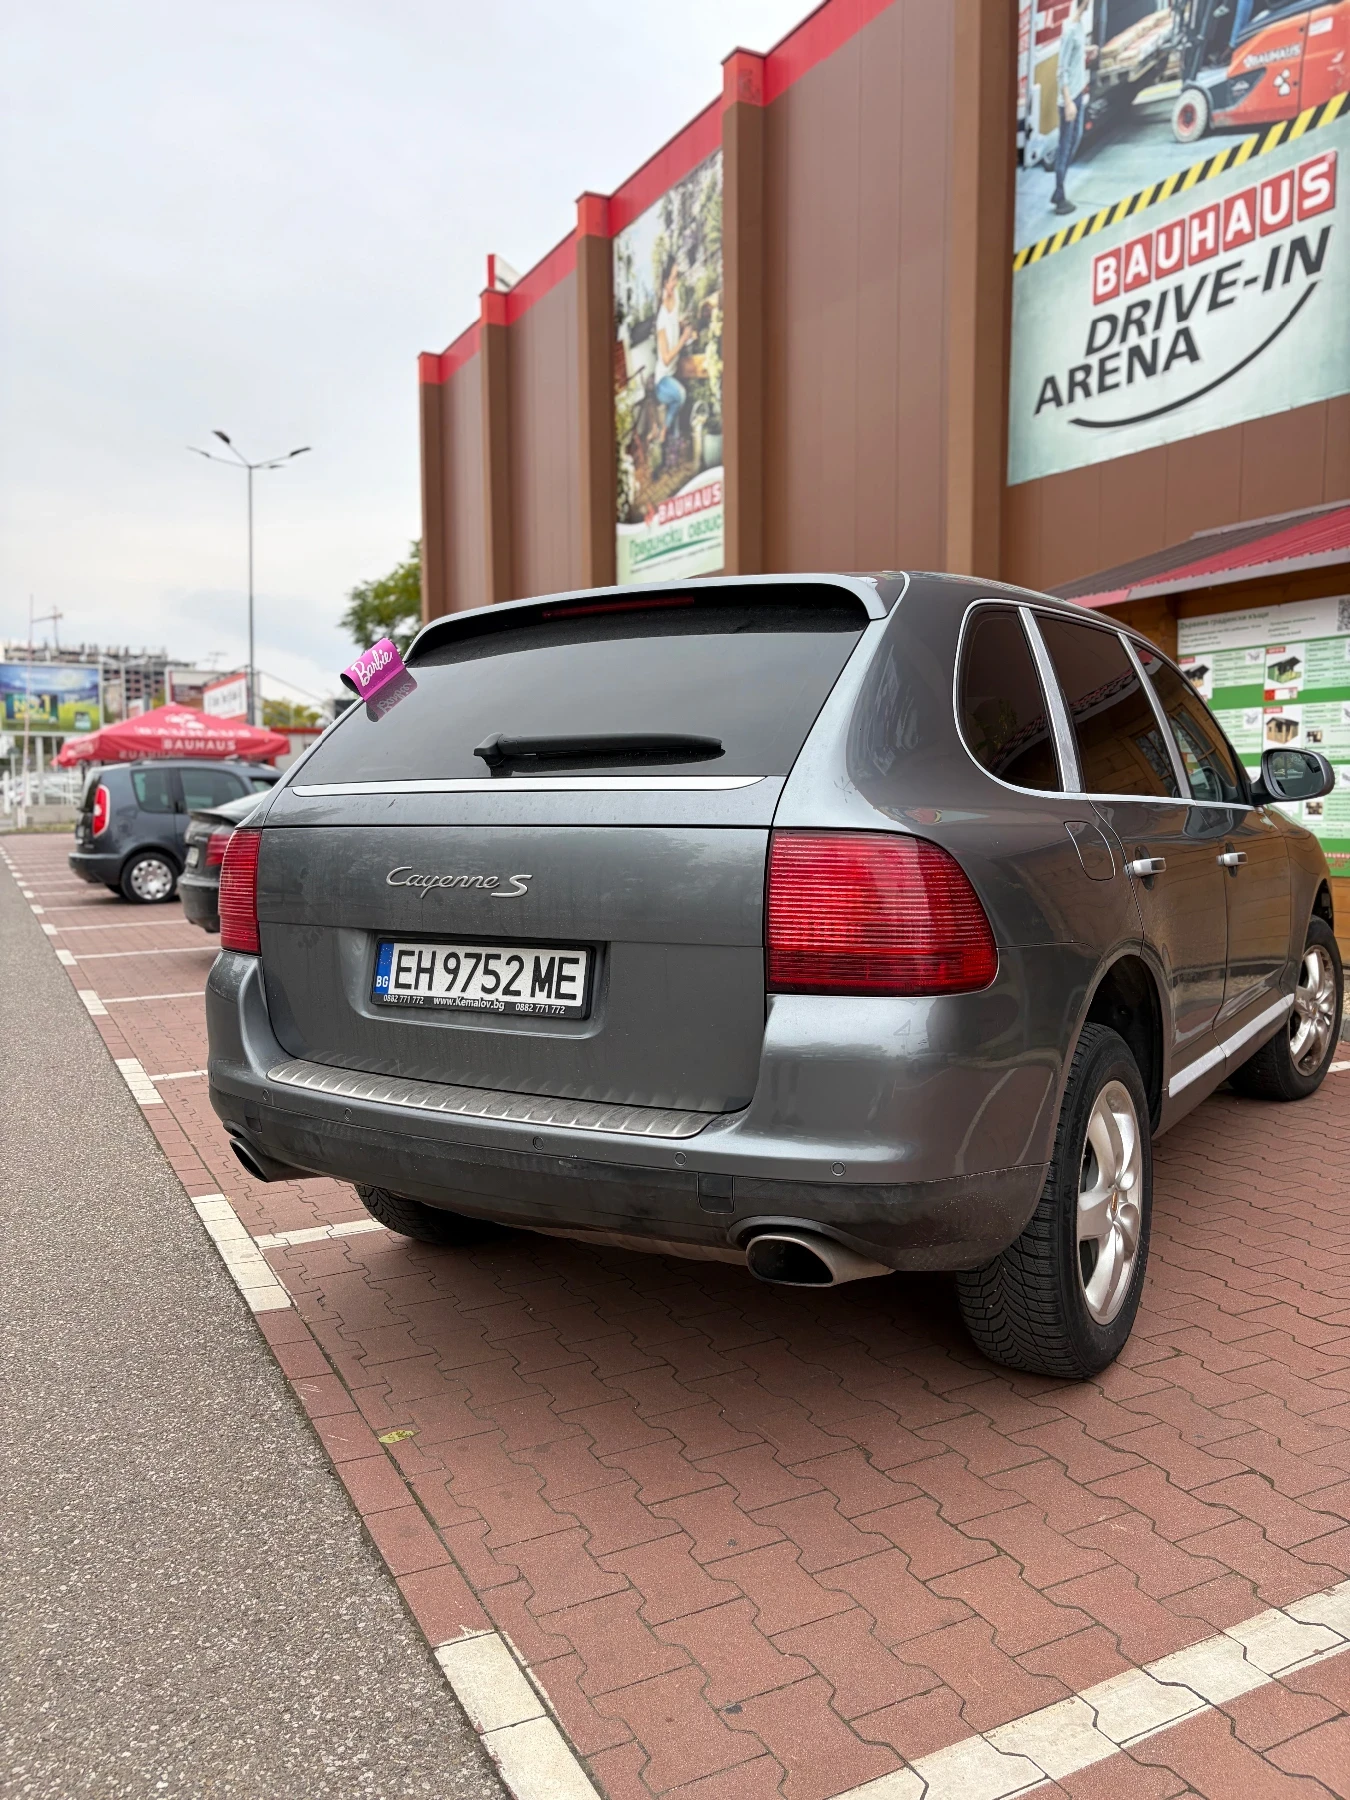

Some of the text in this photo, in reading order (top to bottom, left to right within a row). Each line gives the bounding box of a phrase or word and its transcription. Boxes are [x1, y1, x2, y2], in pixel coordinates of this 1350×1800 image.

[1095, 158, 1332, 298] BAUHAUS
[1084, 224, 1333, 356] DRIVE-IN
[1034, 325, 1200, 416] ARENA
[658, 482, 721, 525] BAUHAUS
[350, 648, 394, 687] Barbie
[163, 738, 236, 751] BAUHAUS
[386, 866, 533, 899] Cayenne S
[375, 975, 389, 988] BG
[383, 994, 425, 1005] 0882 771 772
[433, 996, 505, 1011] www.Kemalov.bg
[515, 1003, 566, 1014] 0882 771 772
